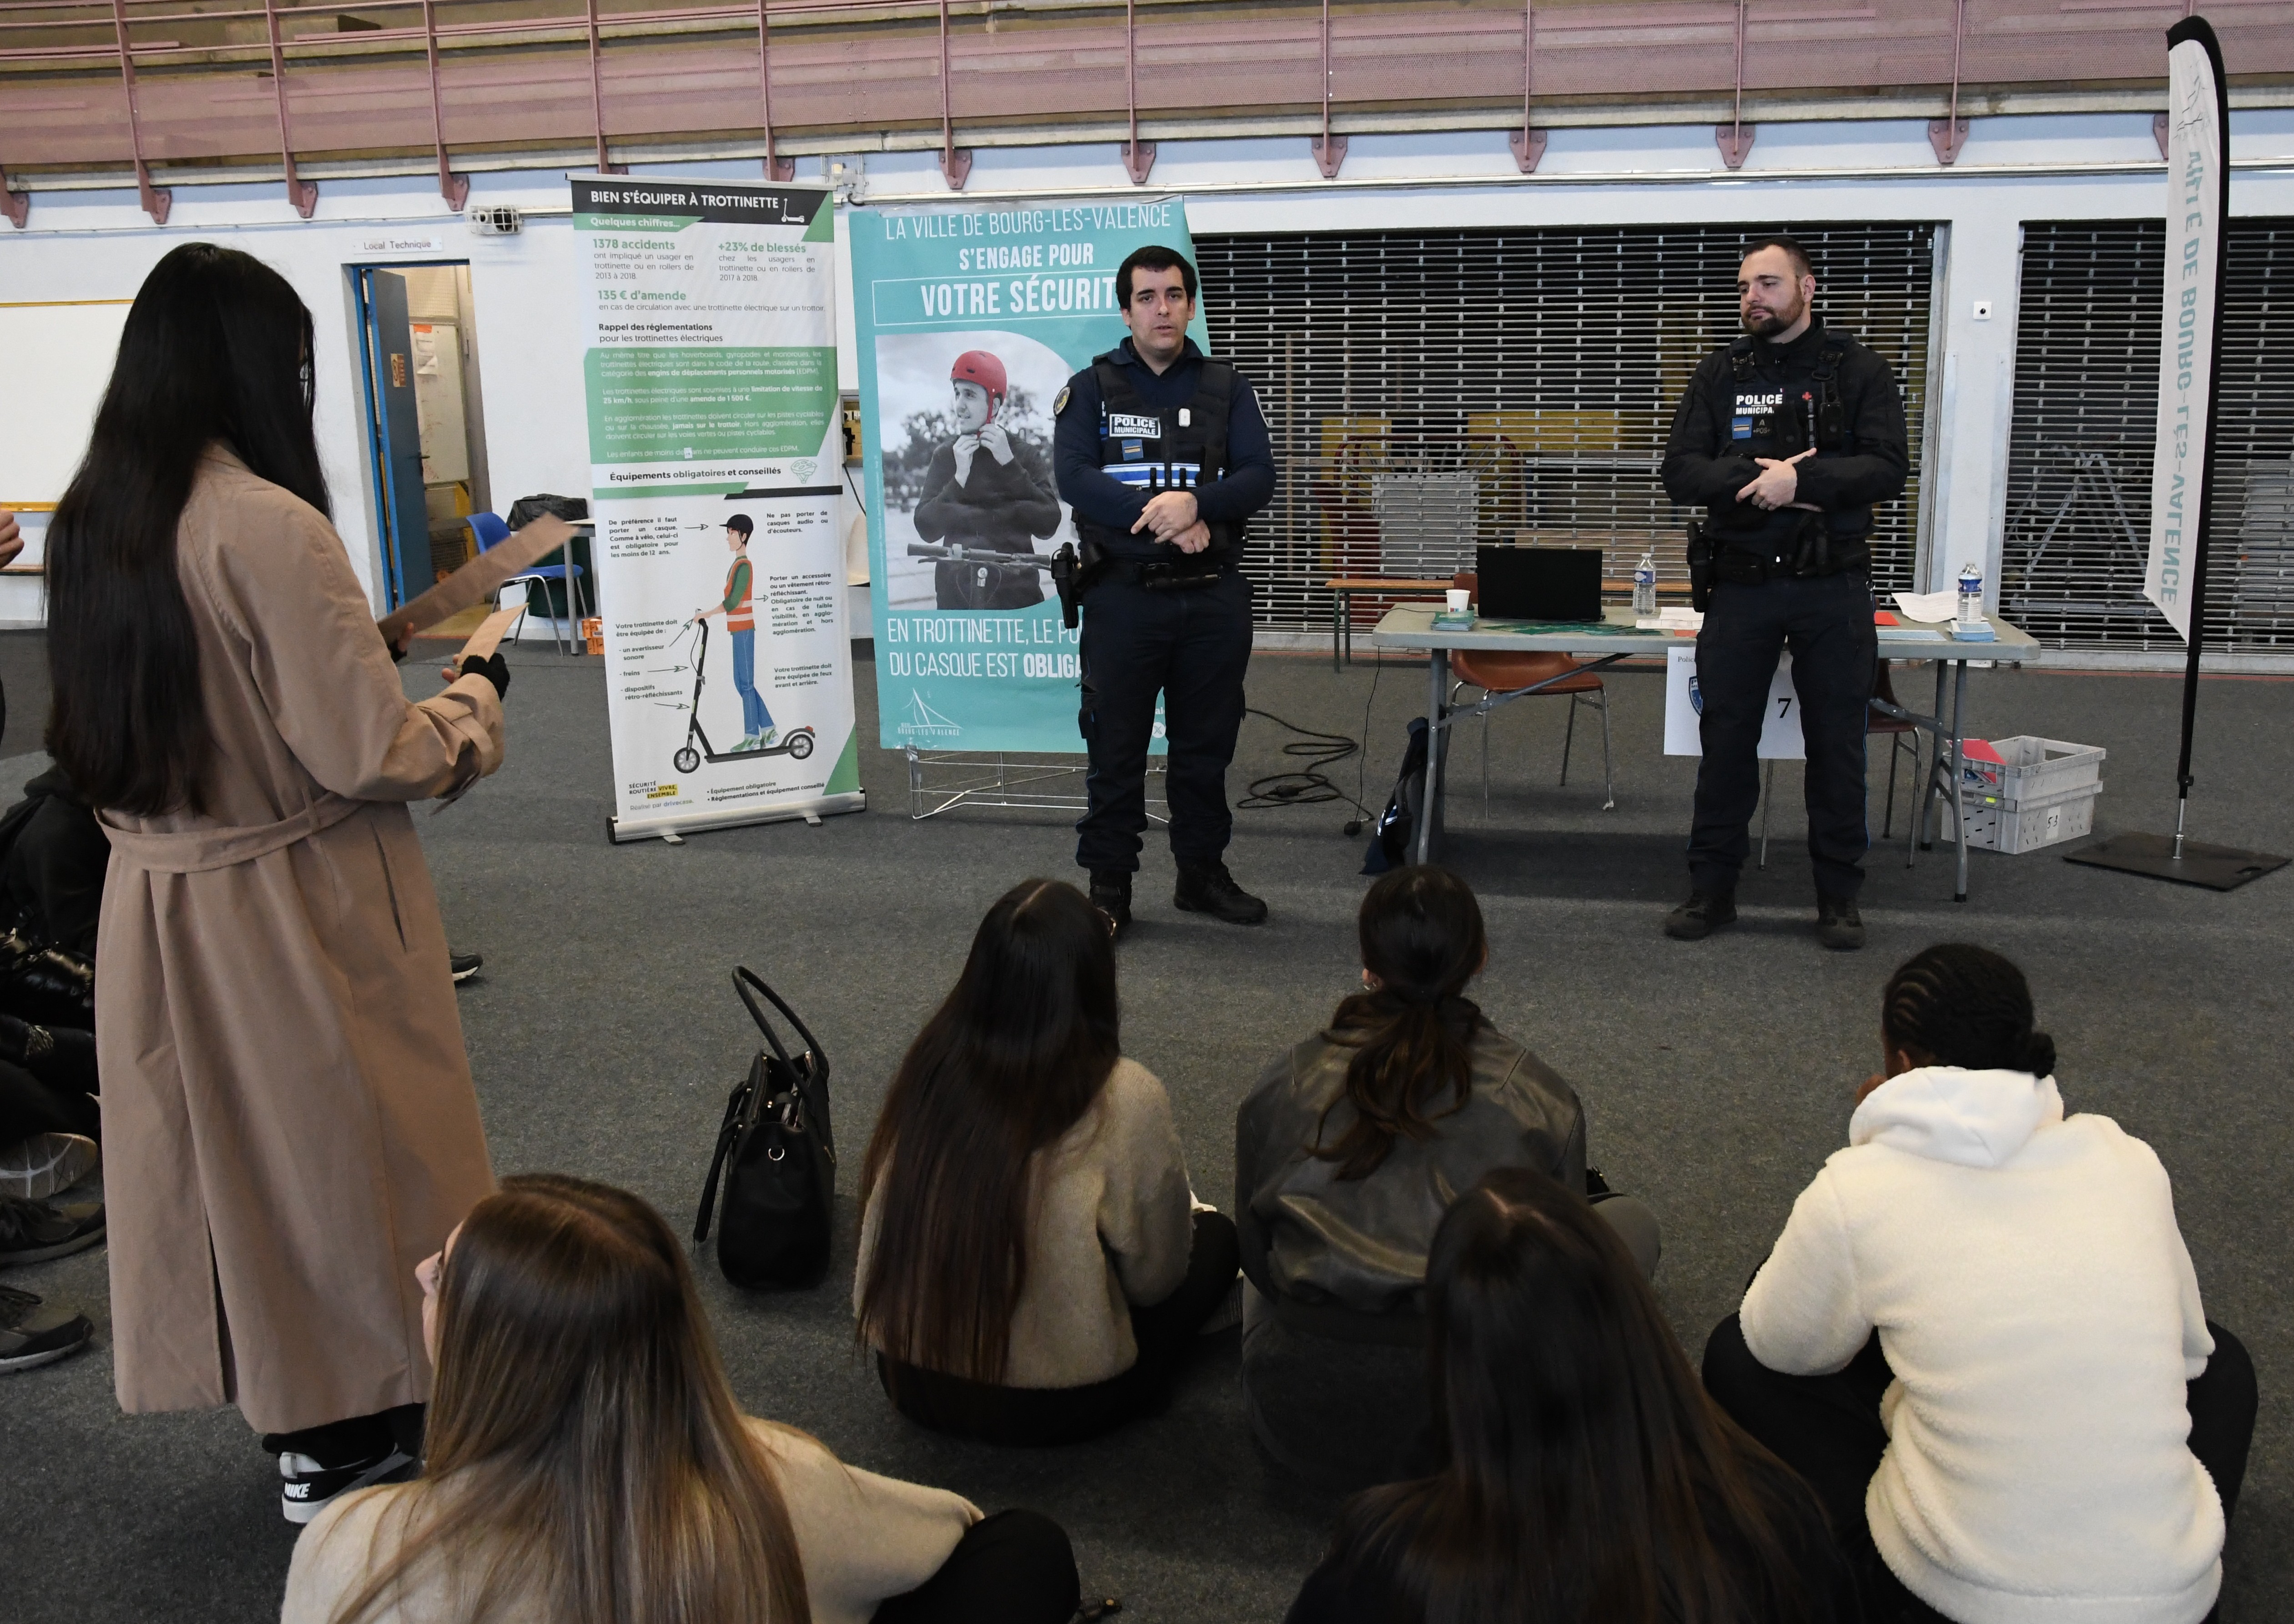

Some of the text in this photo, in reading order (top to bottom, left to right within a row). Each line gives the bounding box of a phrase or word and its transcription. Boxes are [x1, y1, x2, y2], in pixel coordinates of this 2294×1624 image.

[591, 190, 778, 208] BIEN S'ÉQUIPER À TROTTINETTE
[590, 217, 680, 227] Quelques chiffres...
[886, 205, 1170, 240] LA VILLE DE BOURG-LES-VALENCE
[364, 241, 431, 250] Local Technique
[593, 239, 675, 250] 1378 accidents
[719, 242, 806, 252] +23% de blessés
[610, 252, 641, 261] impliqué
[960, 243, 1093, 270] S'ENGAGE POUR
[598, 290, 686, 300] 135 € d'amende
[921, 274, 1116, 316] VOTRE SÉCURIT
[744, 304, 777, 313] électrique
[599, 323, 628, 332] Rappel
[647, 323, 712, 332] réglementations
[1736, 394, 1783, 405] POLICE
[1735, 407, 1775, 415] MUNICIPA
[1114, 417, 1156, 428] POLICE
[1114, 426, 1156, 435] MUNICIPALE
[610, 472, 671, 482] Équipements
[673, 469, 726, 479] obligatoires
[739, 467, 781, 475] conseillés
[888, 618, 1082, 645] EN TROTTINETTE, LE PO
[890, 652, 1081, 678] DU CASQUE EST OBLIGA
[625, 690, 682, 700] rétro-réfléchissants
[1778, 698, 1792, 718] 7
[629, 780, 656, 790] SÉCURITÉ
[711, 782, 776, 794] Équipement obligatoire
[711, 792, 758, 802] Réglementations
[767, 786, 799, 795] équipement
[801, 783, 825, 792] conseillé
[284, 1482, 311, 1498] NIKE
